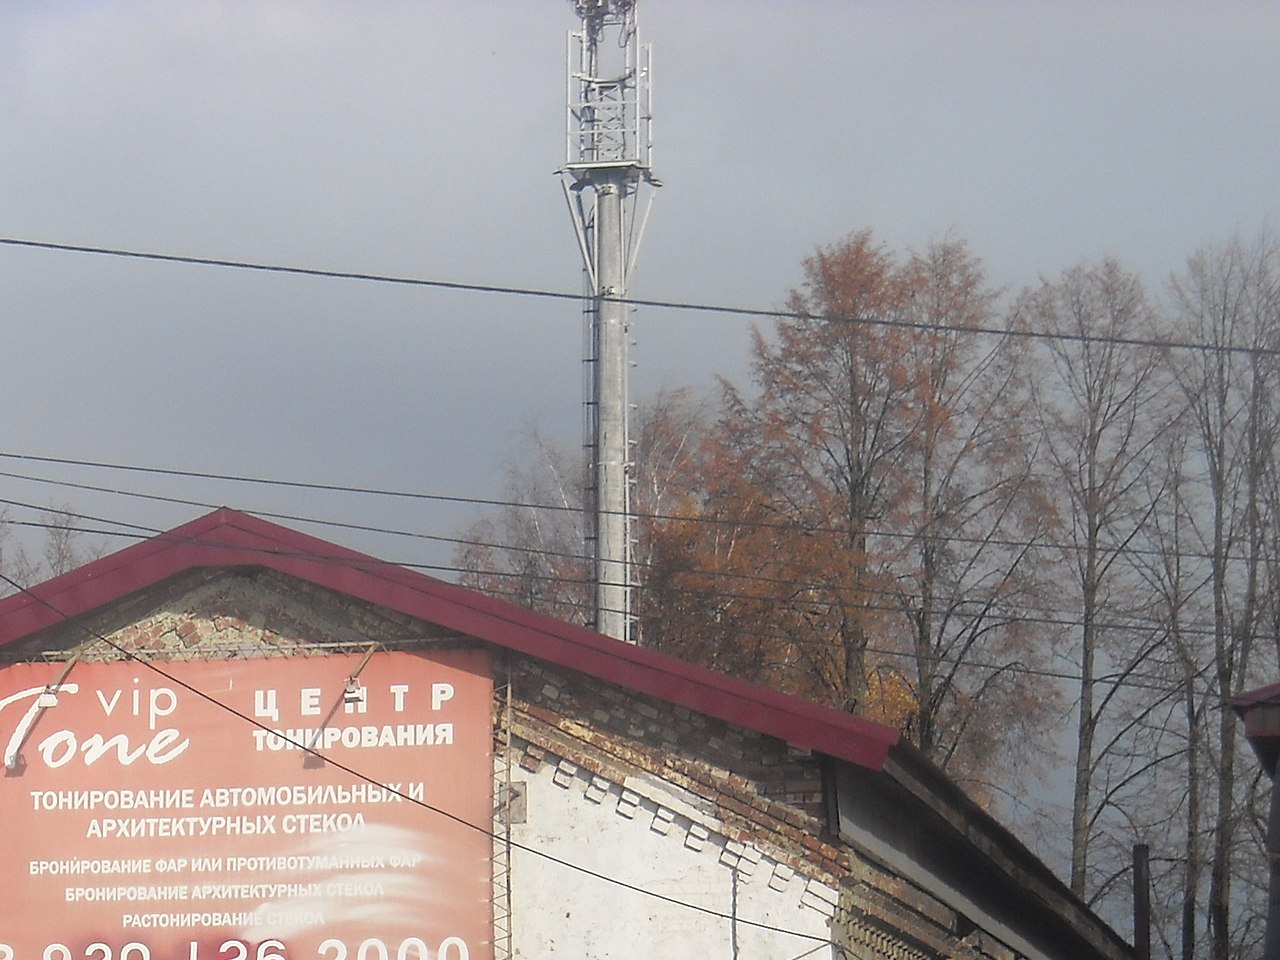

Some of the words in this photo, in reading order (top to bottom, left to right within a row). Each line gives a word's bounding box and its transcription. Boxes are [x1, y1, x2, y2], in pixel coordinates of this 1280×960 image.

[96, 678, 178, 730] vip
[254, 683, 455, 722] ЦЕНТР
[252, 723, 454, 751] ТОНИРОВАНИЯ
[30, 789, 195, 811] ТОНИРОВАНИЕ
[199, 783, 403, 807] АВТОМОБИЛЬНЫХ
[408, 782, 425, 802] И
[86, 814, 277, 838] АРХИТЕКТУРНЫХ
[282, 812, 366, 834] СТЕКОЛ
[29, 858, 152, 876] БРОНИРОВАНИЕ
[155, 858, 188, 874] ФАР
[191, 857, 222, 873] ИЛИ
[226, 855, 386, 872] ПРОТИВОТУМАННЫХ
[388, 853, 423, 868] ФАР
[65, 886, 188, 902] БРОНИРОВАНИЕ
[191, 883, 322, 900] АРХИТЕКТУРНЫХ
[326, 882, 385, 897] СТЕКОЛ
[122, 912, 263, 928] РАСТОНИРОВАНИЕ
